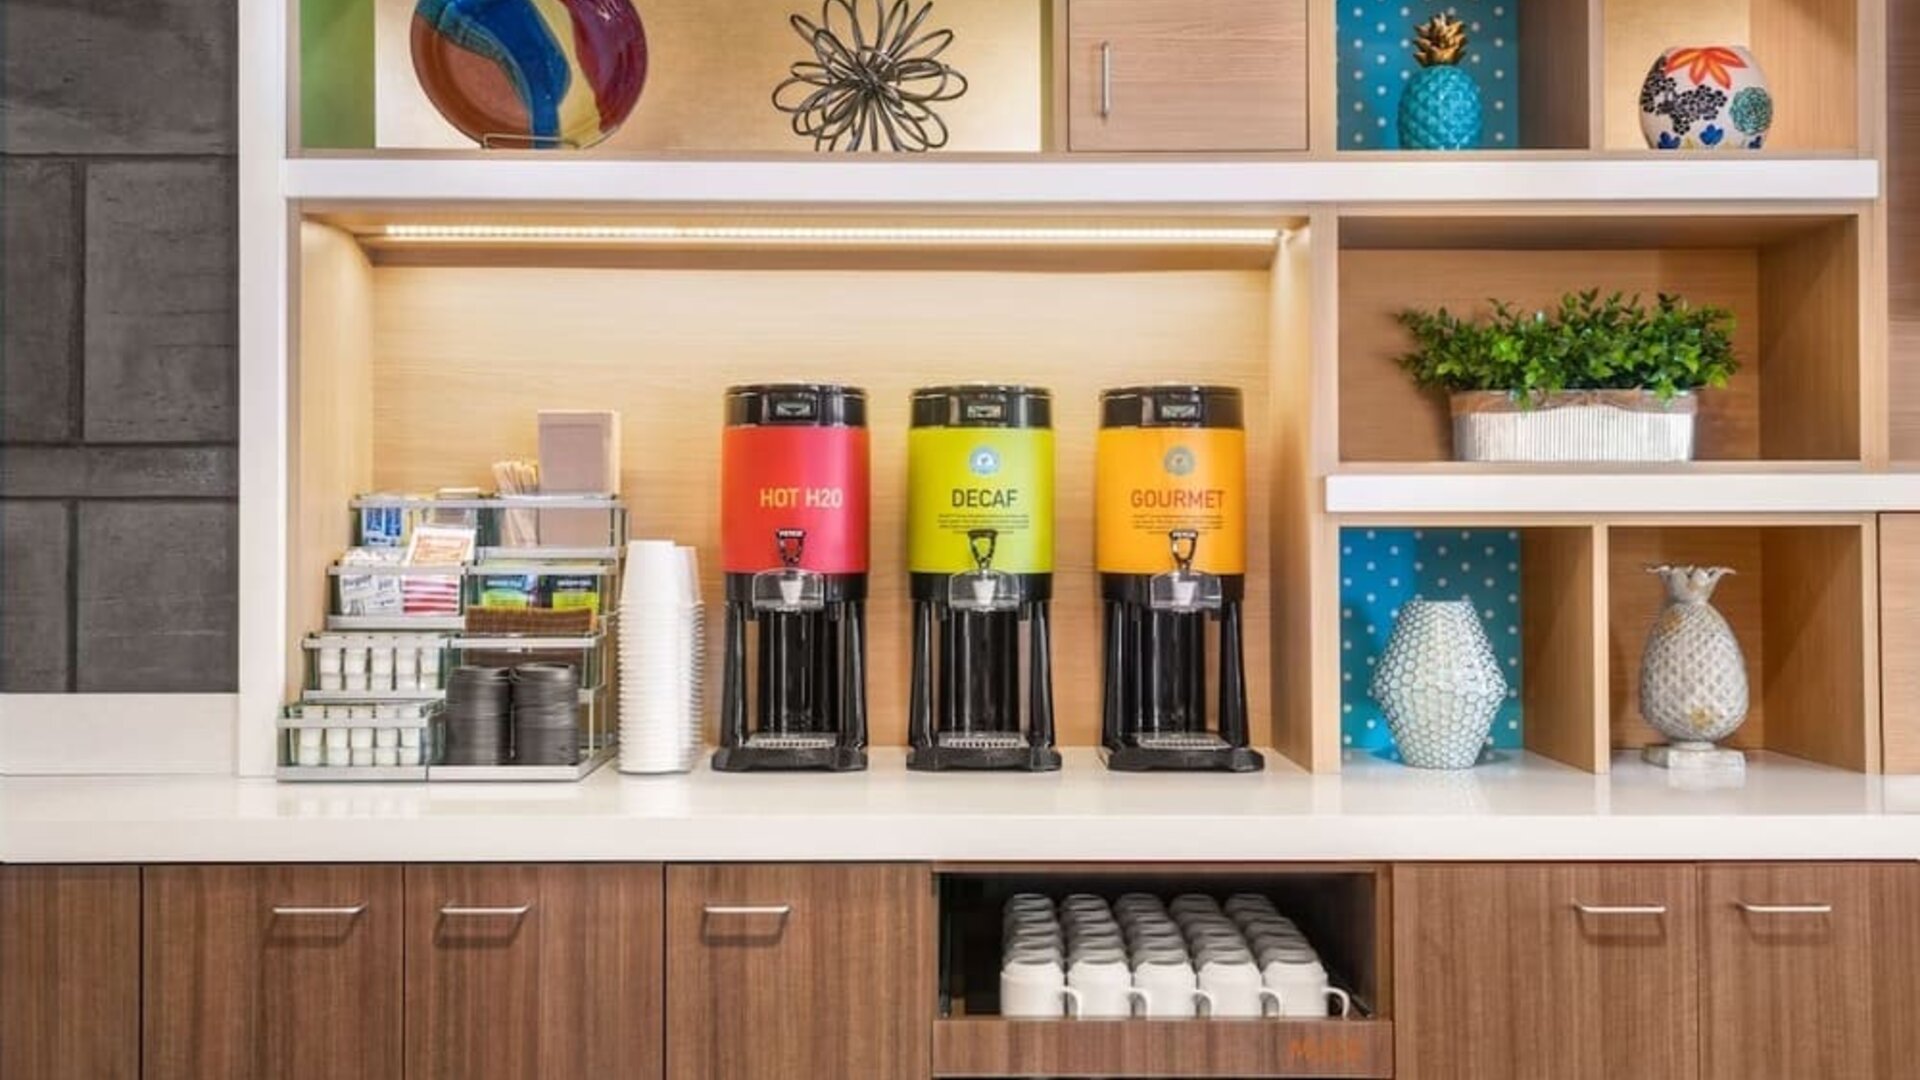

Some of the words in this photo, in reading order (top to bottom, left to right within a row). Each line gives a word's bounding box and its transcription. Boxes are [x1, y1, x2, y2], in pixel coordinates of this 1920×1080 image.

[760, 487, 799, 508] HOT
[951, 488, 1018, 508] DECAF
[1130, 489, 1226, 509] GOURMET
